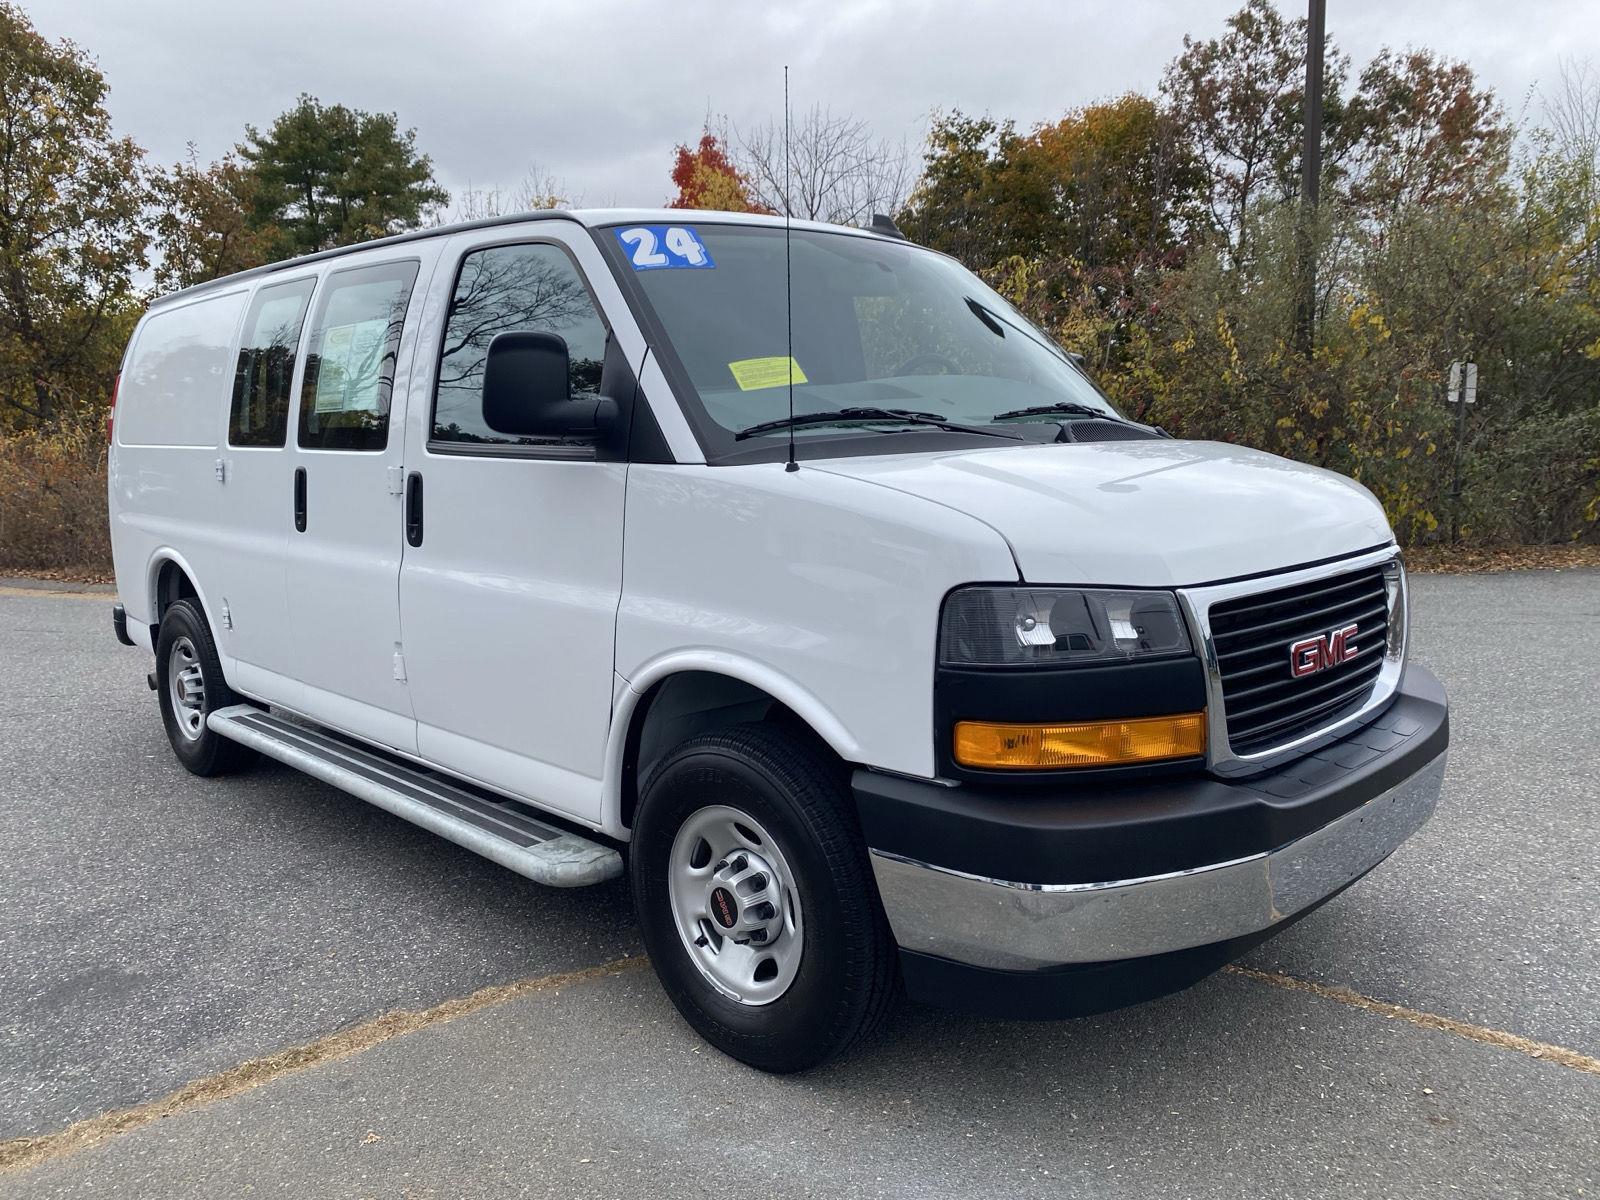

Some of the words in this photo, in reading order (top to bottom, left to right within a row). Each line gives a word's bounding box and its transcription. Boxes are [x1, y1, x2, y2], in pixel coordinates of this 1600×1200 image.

[620, 227, 707, 265] 24
[1291, 623, 1358, 678] GMC
[715, 889, 733, 926] GMC
